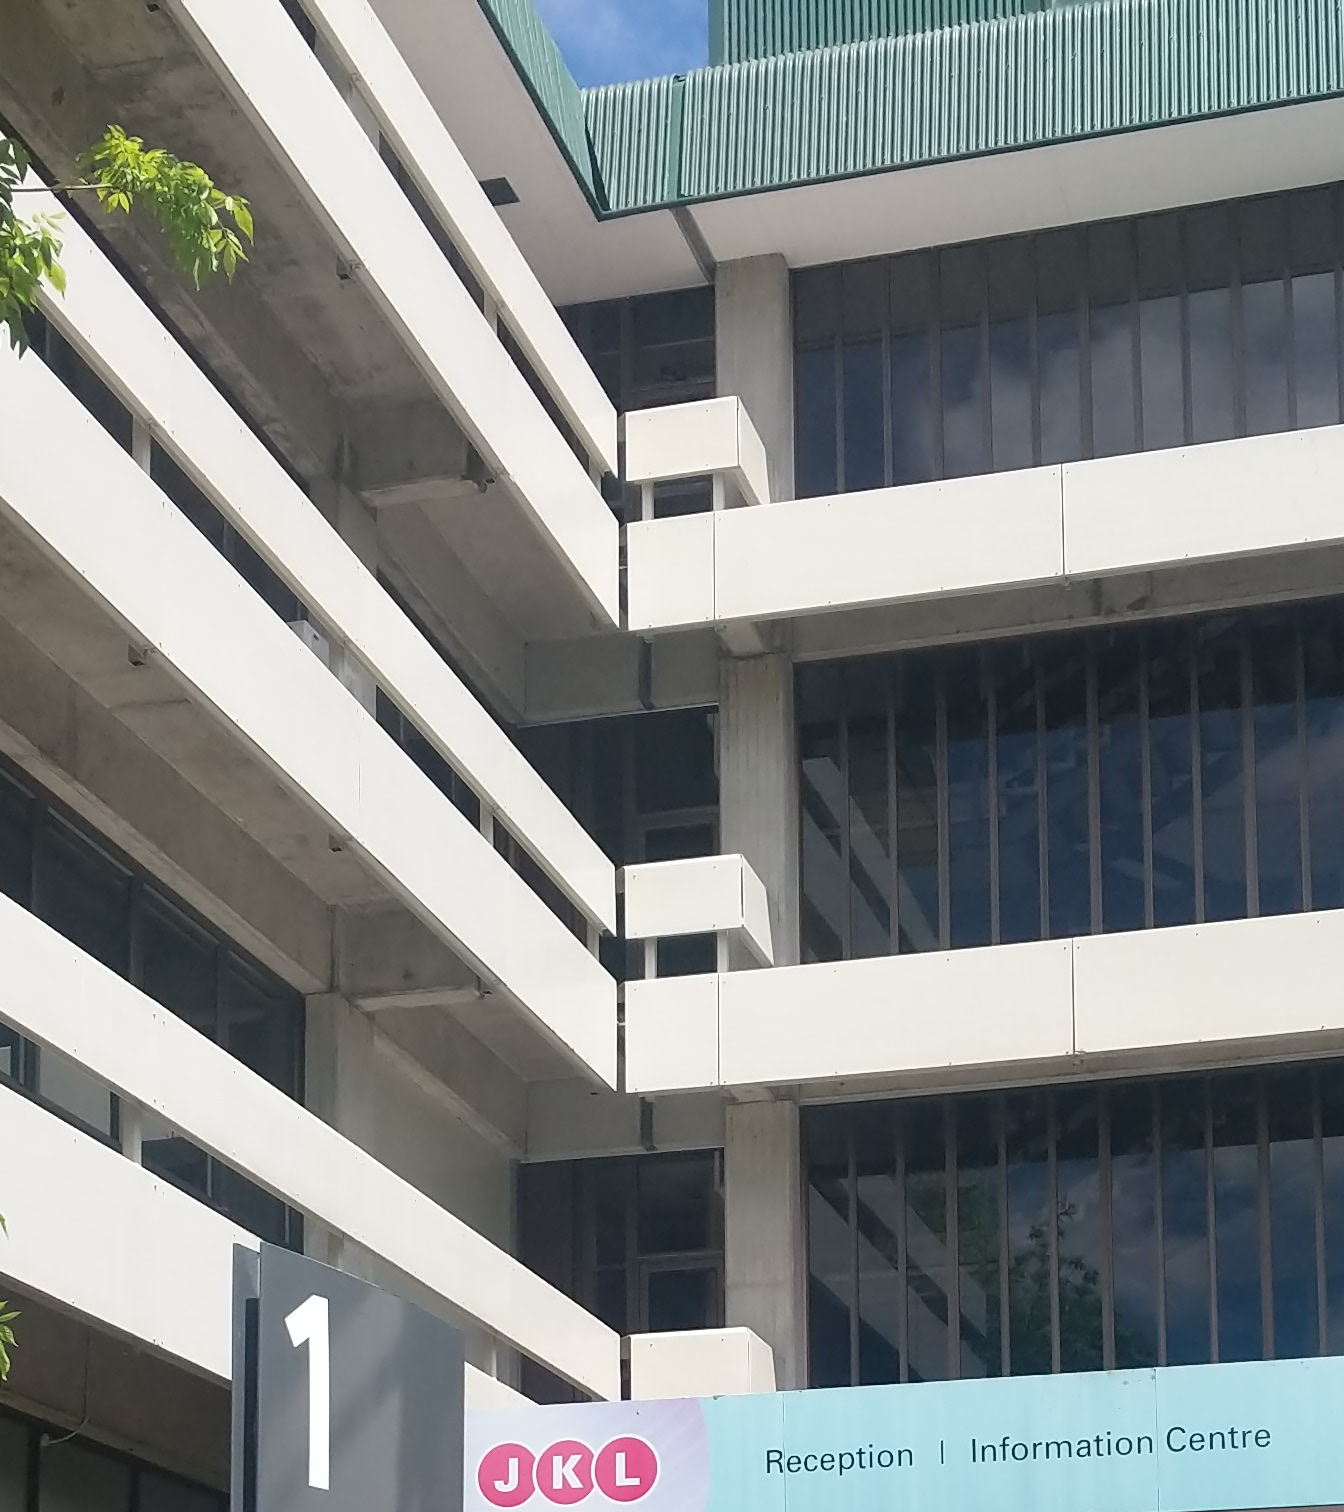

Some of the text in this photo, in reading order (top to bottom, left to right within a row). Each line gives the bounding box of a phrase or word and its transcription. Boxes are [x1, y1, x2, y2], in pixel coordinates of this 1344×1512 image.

[284, 1294, 330, 1490] 1
[765, 1426, 1272, 1477] Reception Information Centre
